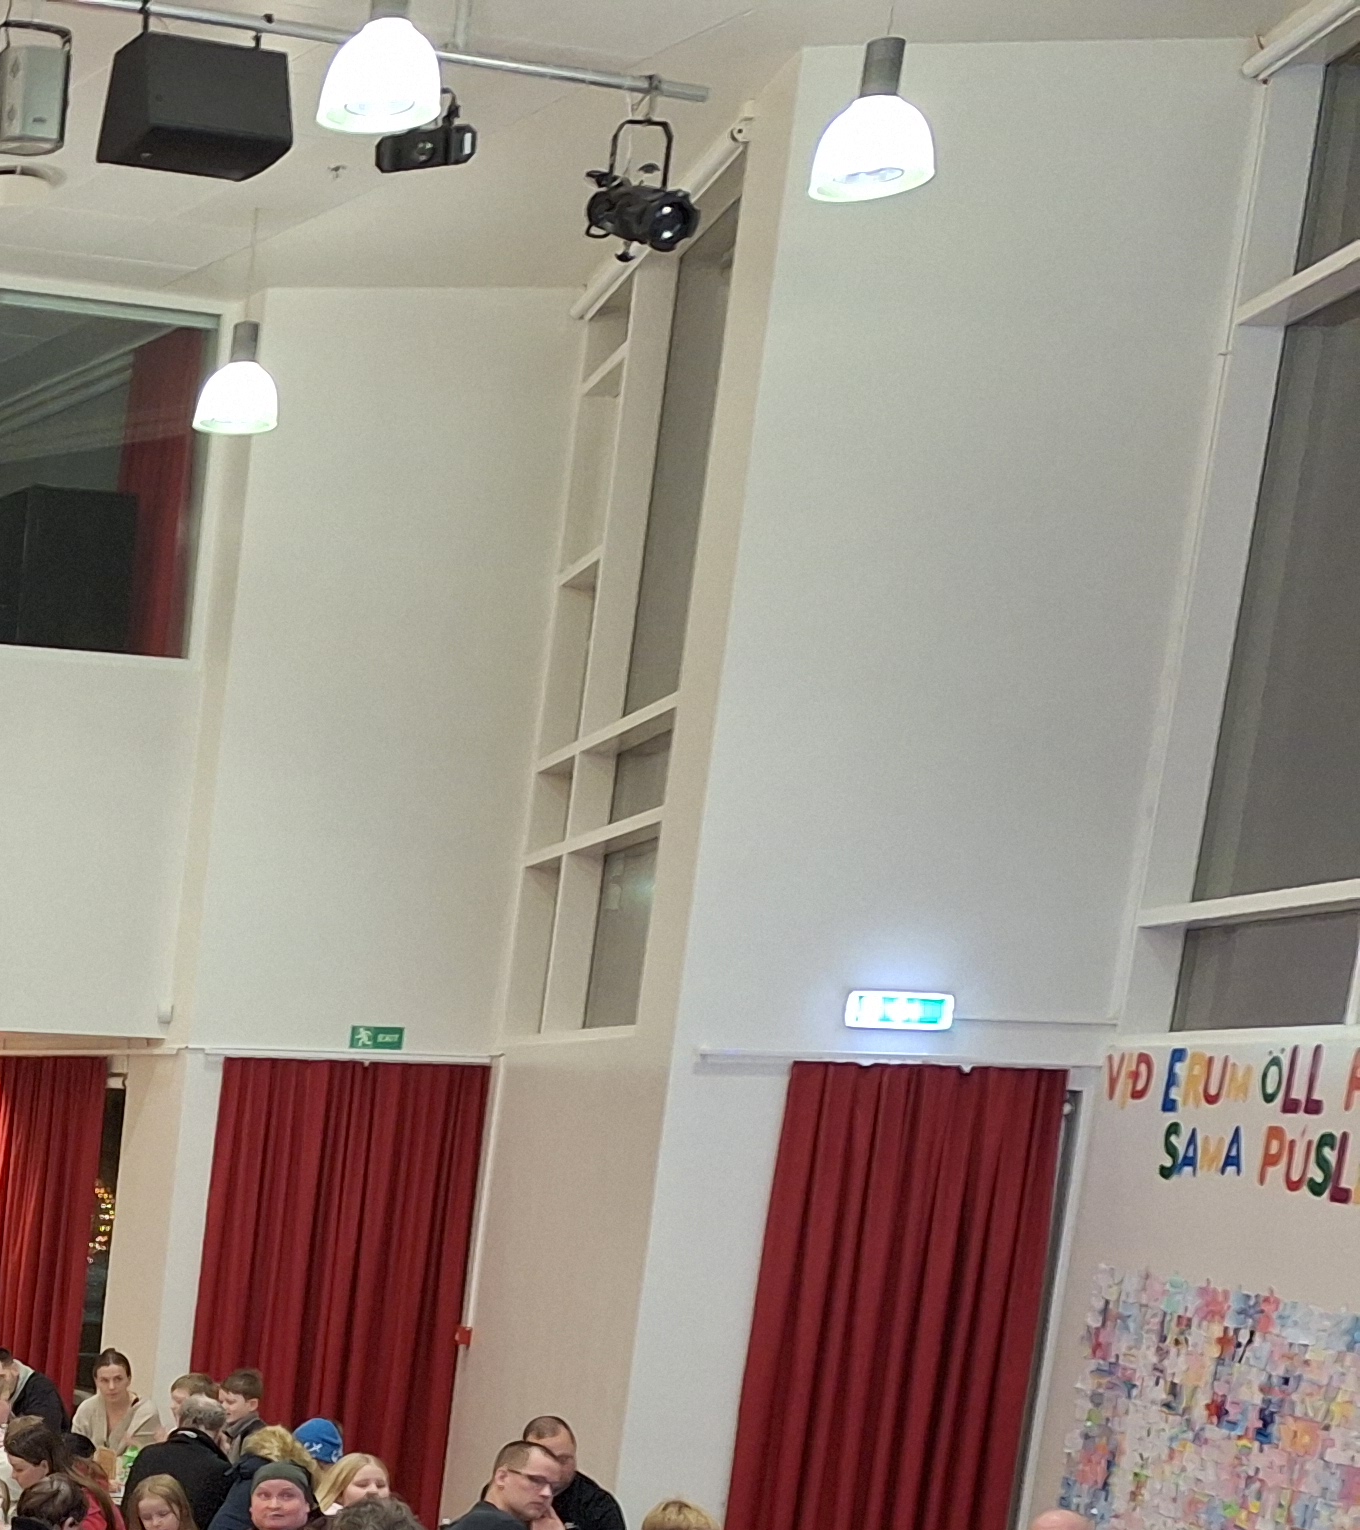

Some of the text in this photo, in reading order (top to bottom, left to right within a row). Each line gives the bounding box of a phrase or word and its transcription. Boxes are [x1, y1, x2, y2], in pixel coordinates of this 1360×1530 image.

[1161, 1047, 1254, 1113] ERUM
[1260, 1043, 1324, 1115] ÖLL
[1159, 1121, 1360, 1205] SAMA PÚSL
